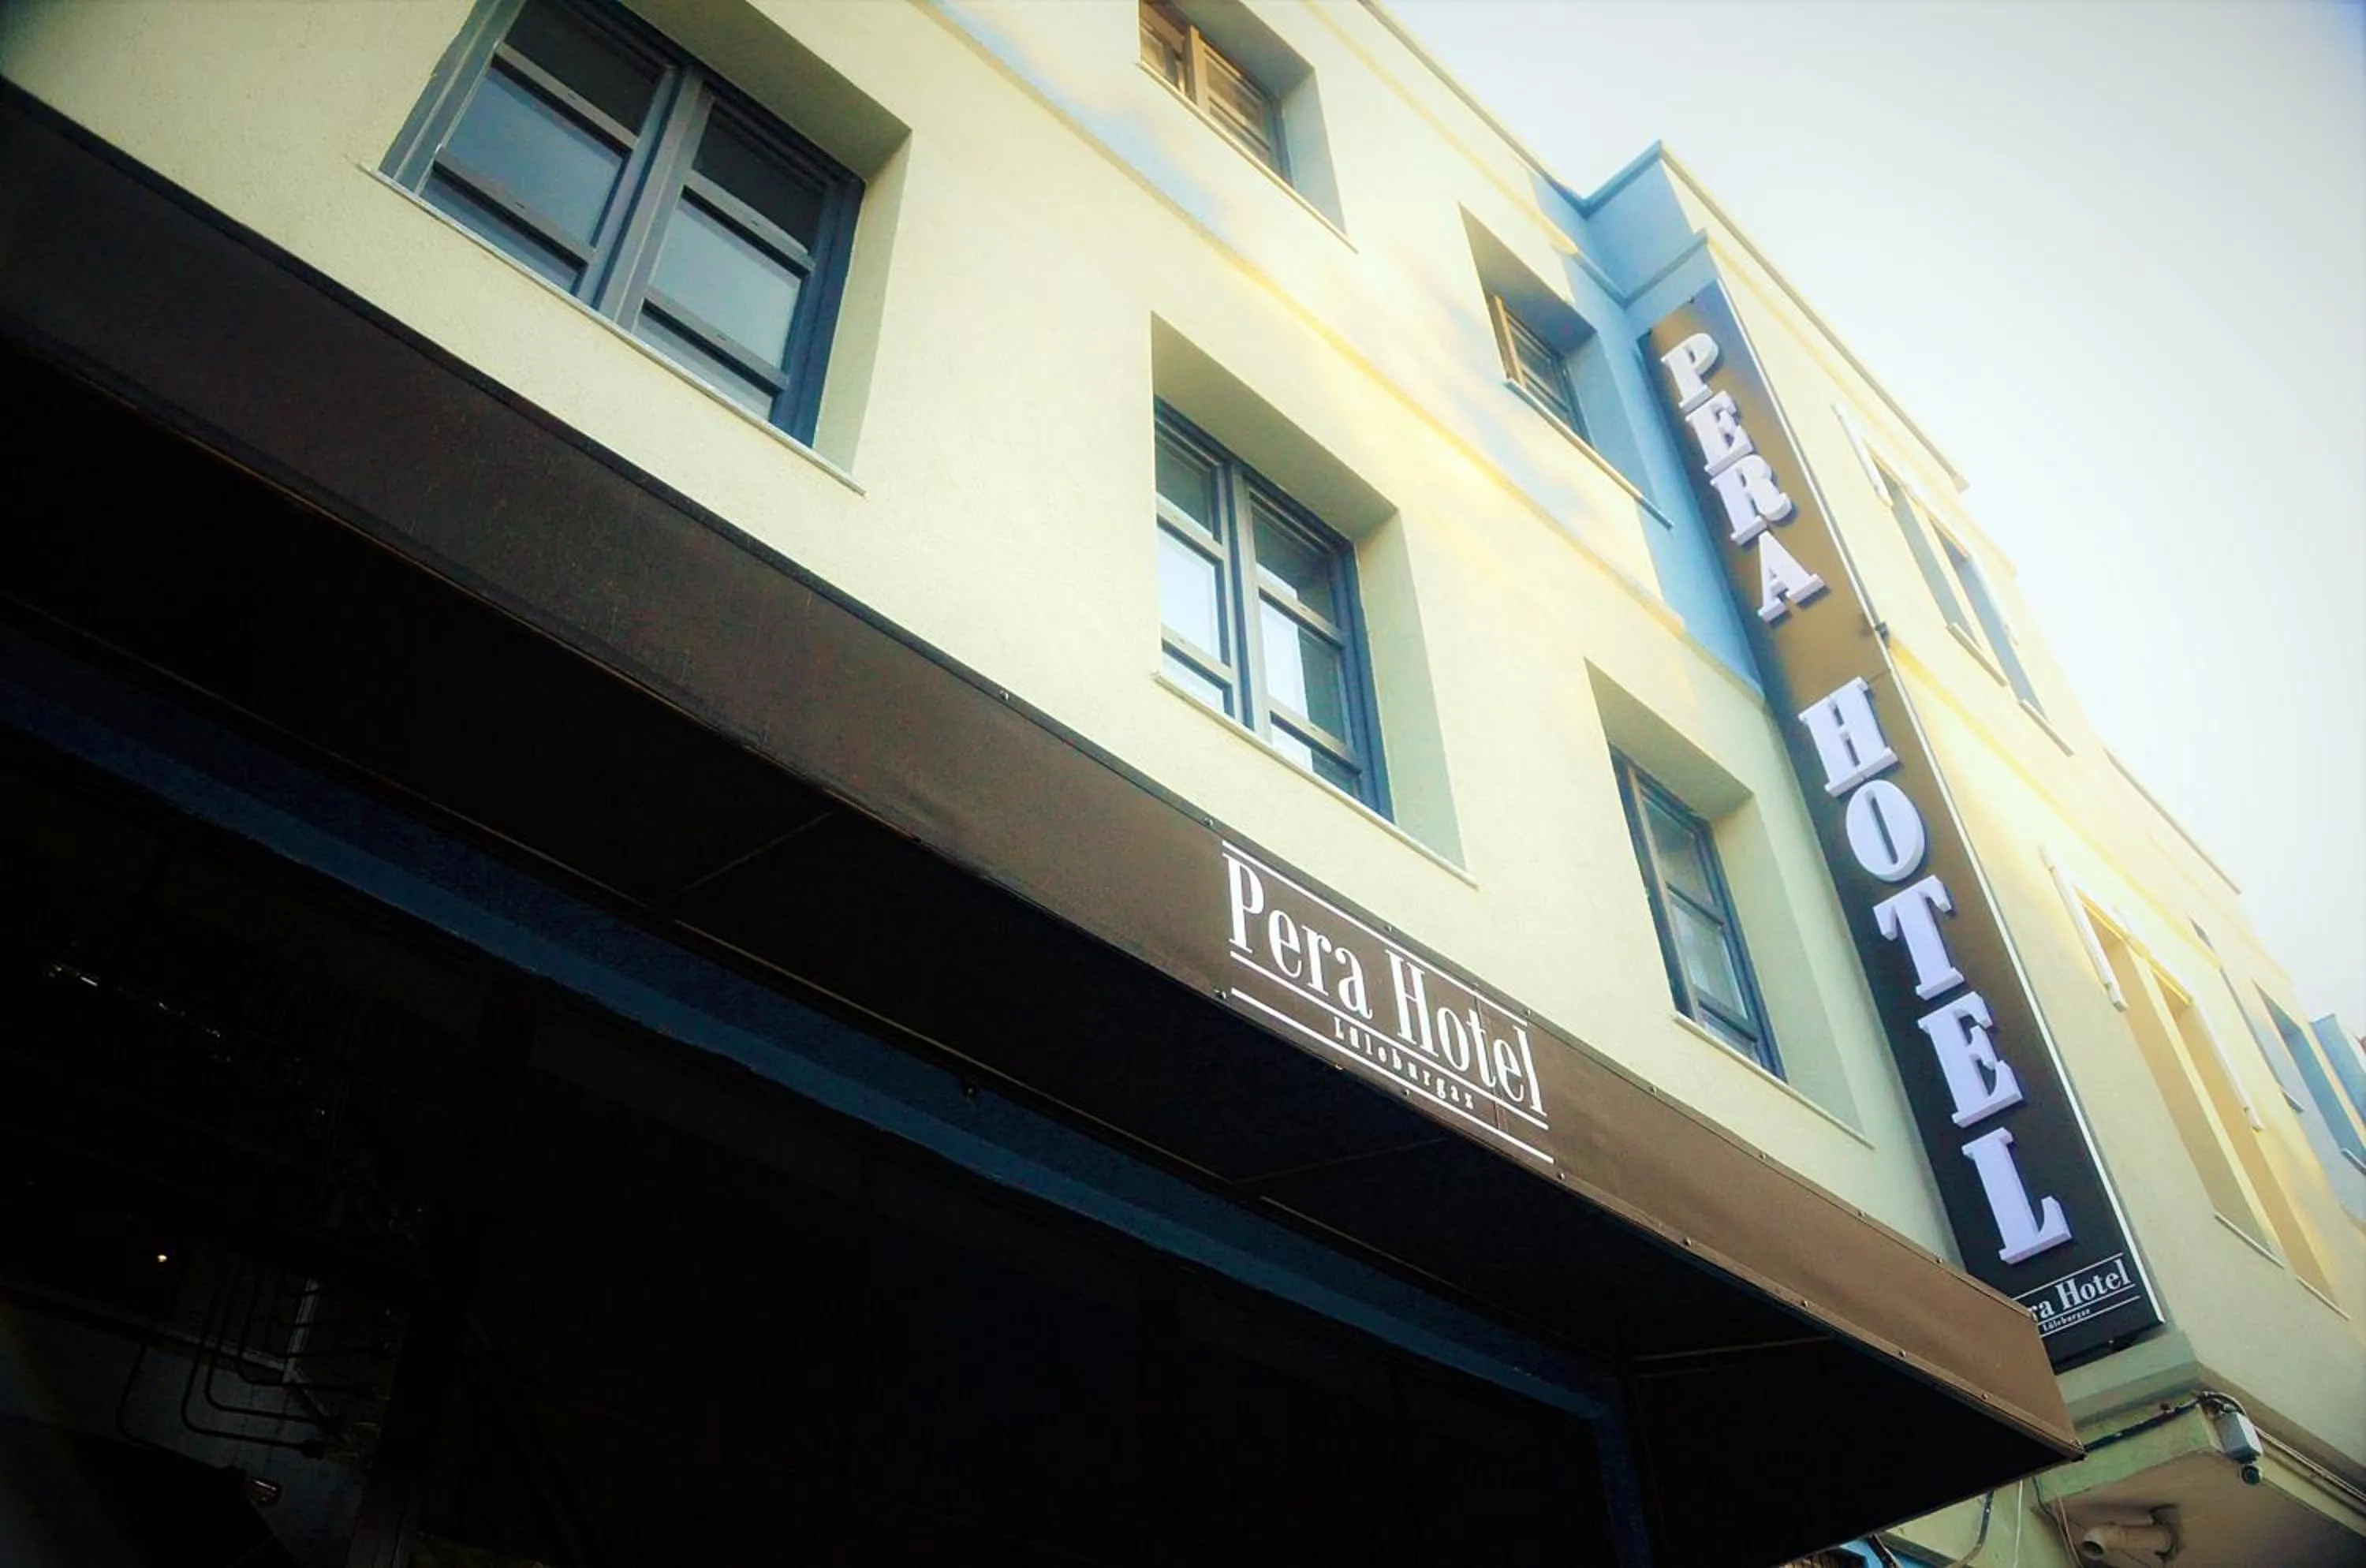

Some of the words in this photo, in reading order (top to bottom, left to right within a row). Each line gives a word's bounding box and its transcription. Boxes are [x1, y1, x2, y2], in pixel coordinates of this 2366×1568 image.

[1660, 333, 1827, 623] PERA
[1798, 676, 2073, 1264] HOTEL
[1222, 852, 1373, 1020] Pera
[1385, 949, 1548, 1118] Hotel
[2025, 1301, 2054, 1322] ra
[2054, 1258, 2130, 1310] Hotel
